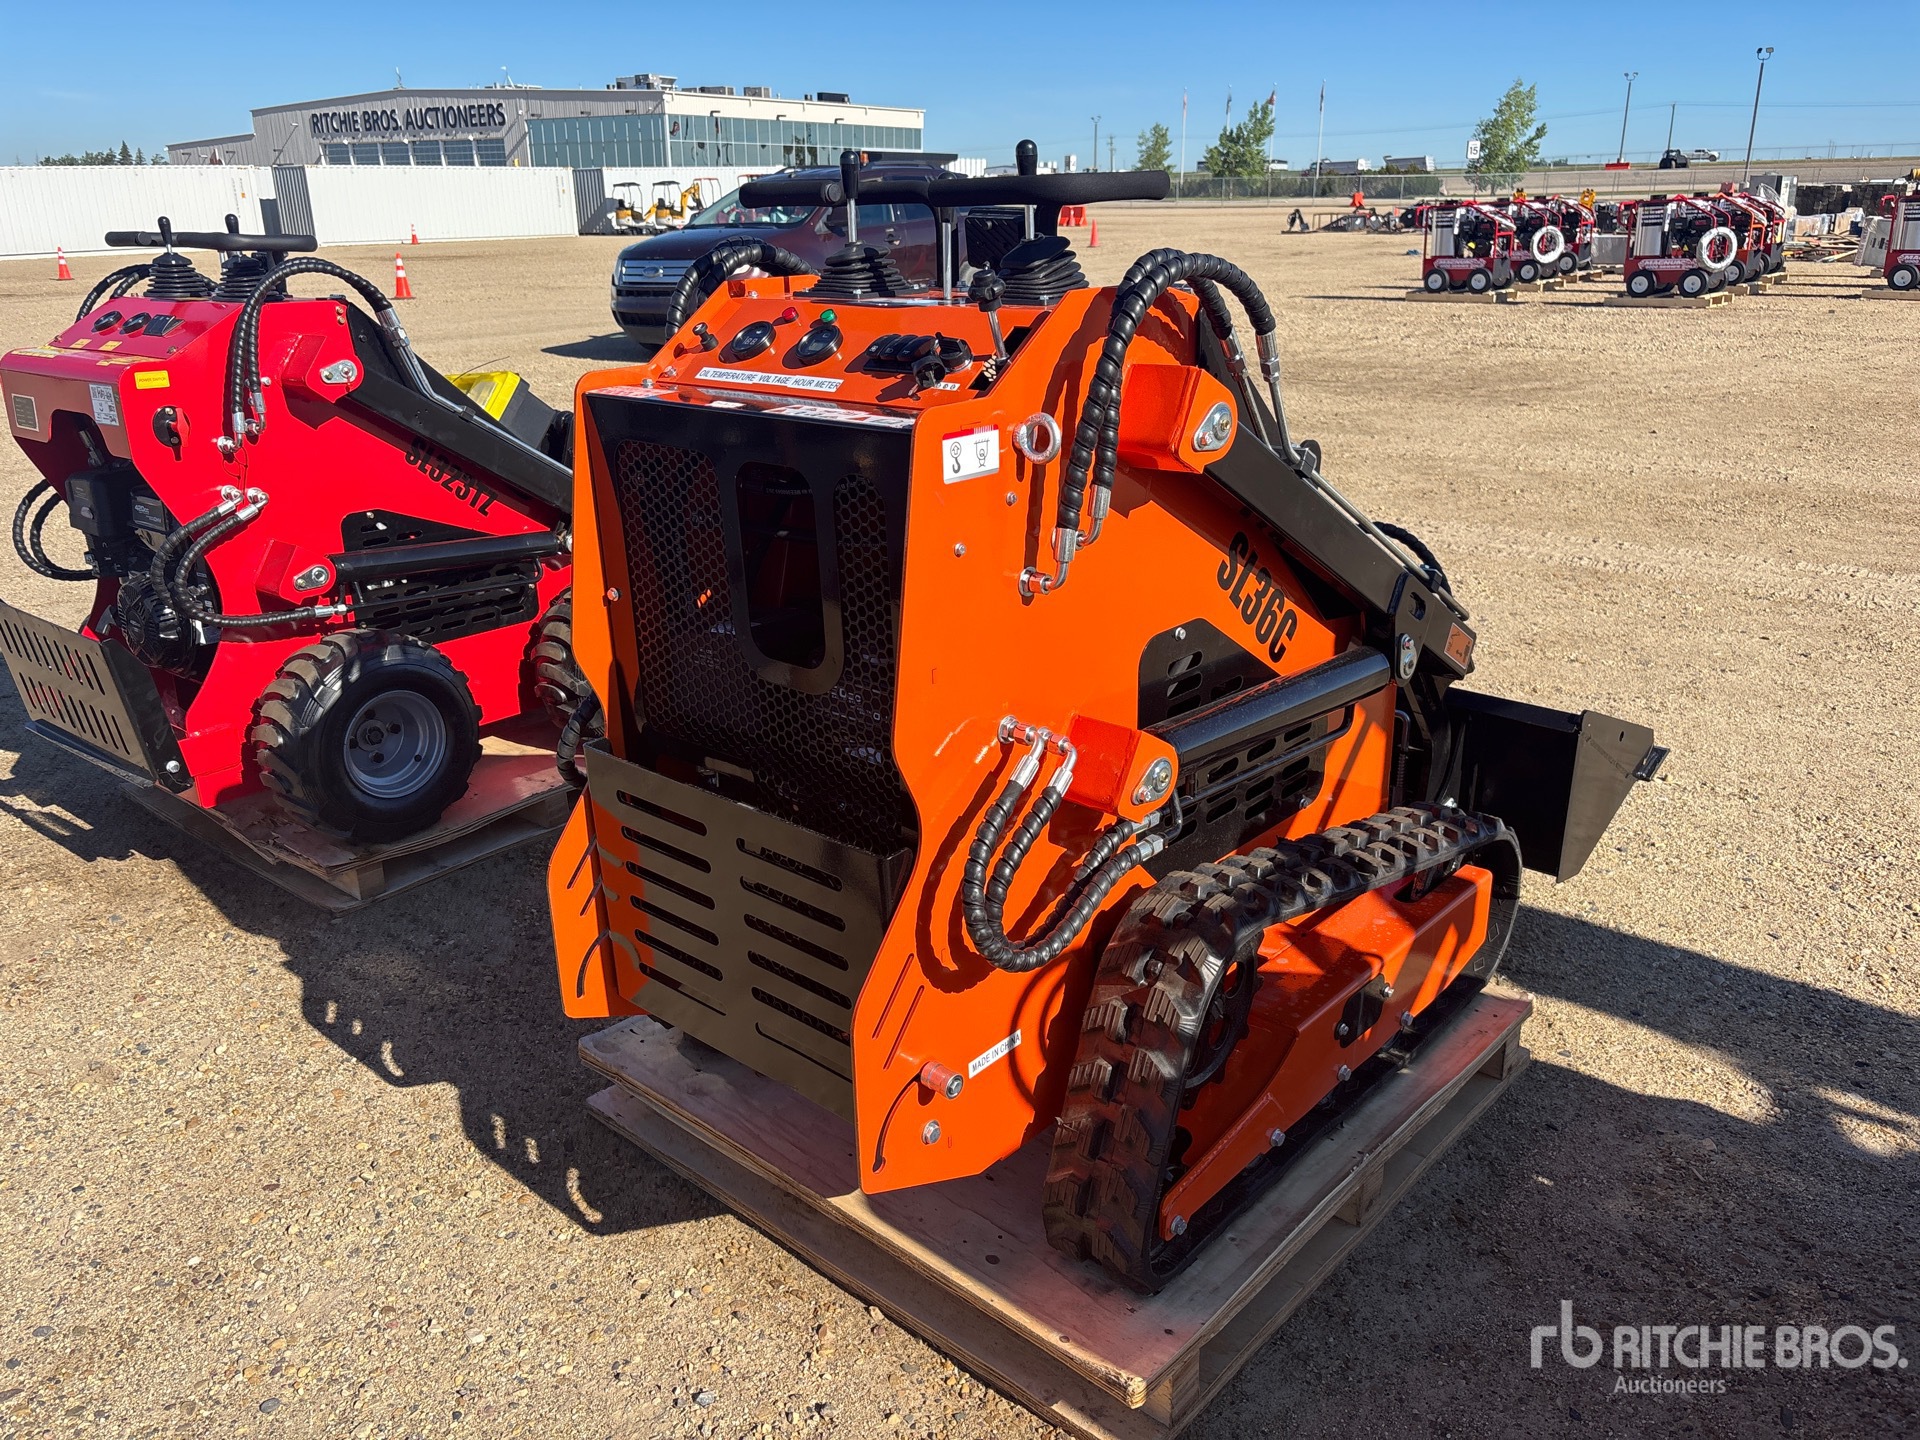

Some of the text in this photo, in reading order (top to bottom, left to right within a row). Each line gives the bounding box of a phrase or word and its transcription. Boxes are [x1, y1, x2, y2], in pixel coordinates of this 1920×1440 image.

[311, 102, 506, 134] RITCHIE BROS. AUCTIONEERS
[1469, 146, 1478, 155] 15
[699, 369, 841, 390] OIL TEMPERATURE VOLTAGE HOUR METER
[405, 439, 499, 517] SL323TZ
[1217, 531, 1298, 663] SL36C
[972, 1033, 1020, 1073] MADE IN CHINA
